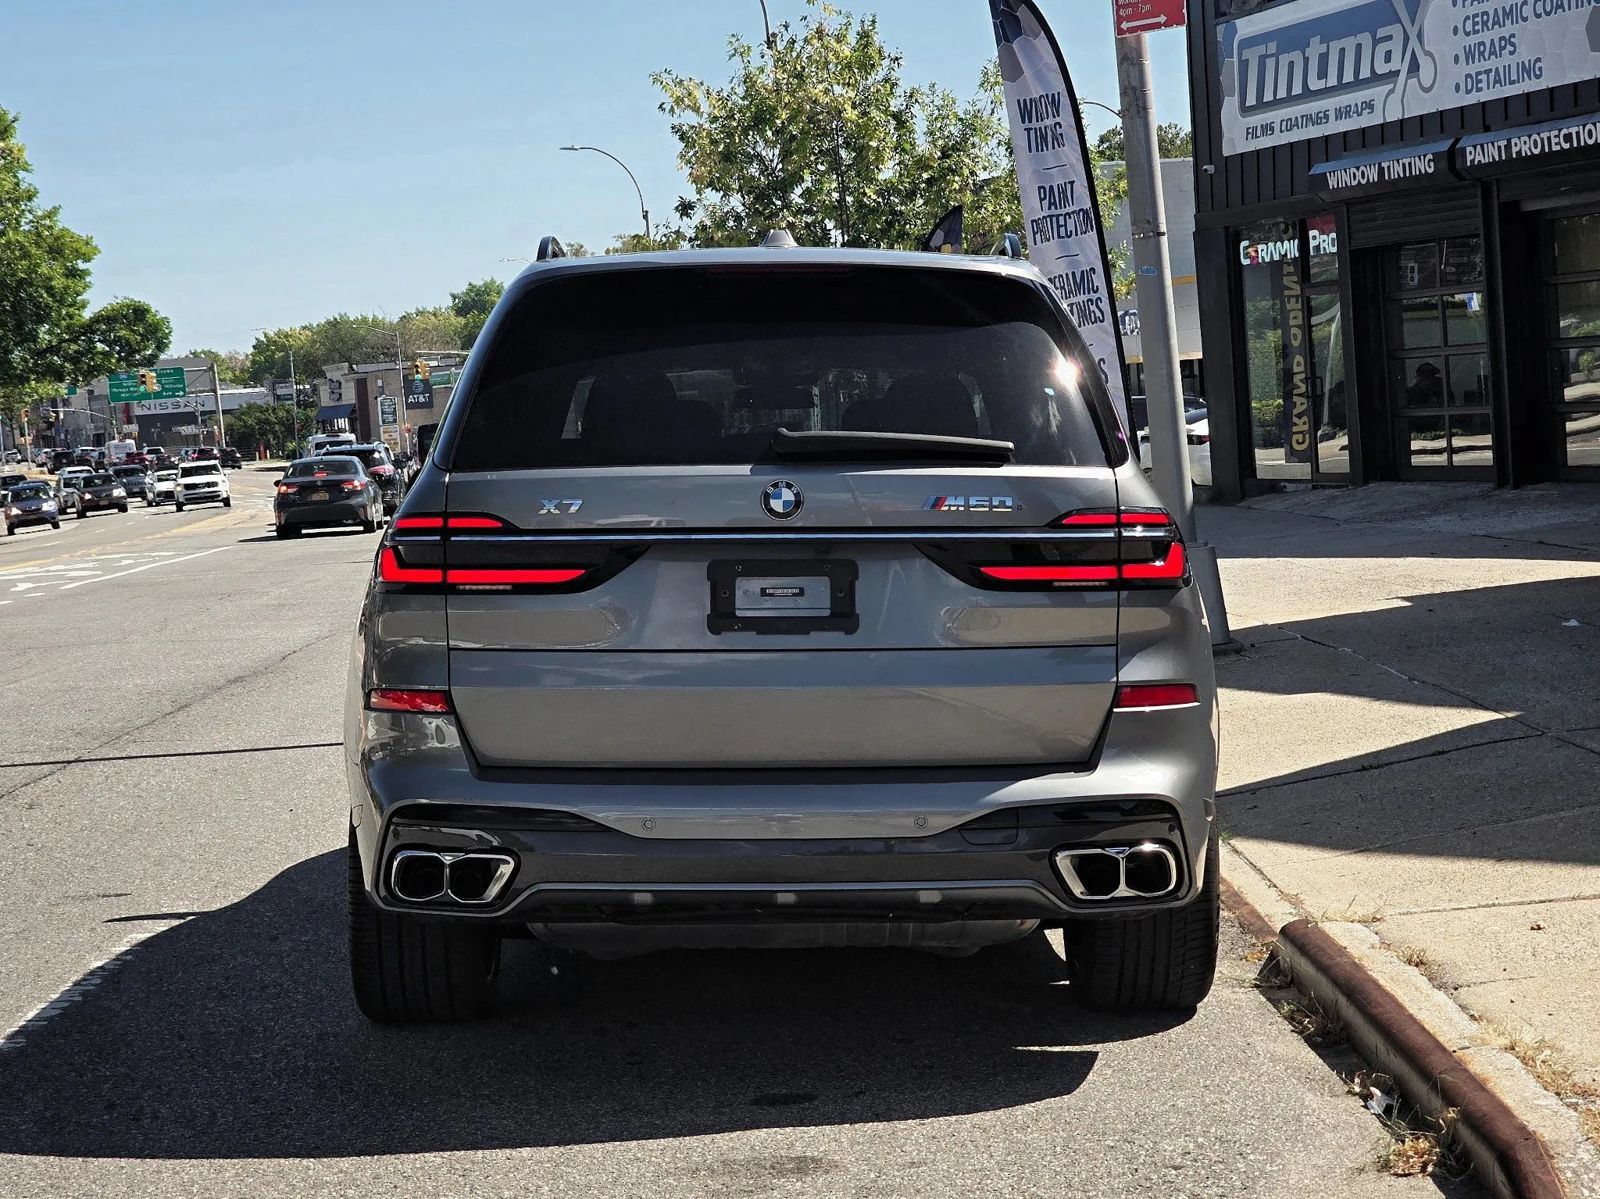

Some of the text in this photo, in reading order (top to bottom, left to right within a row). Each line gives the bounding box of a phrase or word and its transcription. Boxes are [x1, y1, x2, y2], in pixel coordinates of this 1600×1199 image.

[1119, 8, 1133, 17] 4pm
[1138, 4, 1152, 14] 7pm
[1463, 1, 1529, 37] CERAMIC
[1463, 33, 1517, 66] WRAPS
[1464, 57, 1543, 95] DETAILING
[1245, 99, 1375, 141] FILMS COATINGS WRAPS
[1465, 140, 1508, 167] PAINT
[1327, 154, 1435, 190] WINDOW TINTING
[1037, 180, 1076, 212] PAINT
[1067, 296, 1105, 328] TINGS
[141, 400, 205, 411] NISSAN
[408, 394, 430, 403] AT&T
[537, 498, 583, 515] X7
